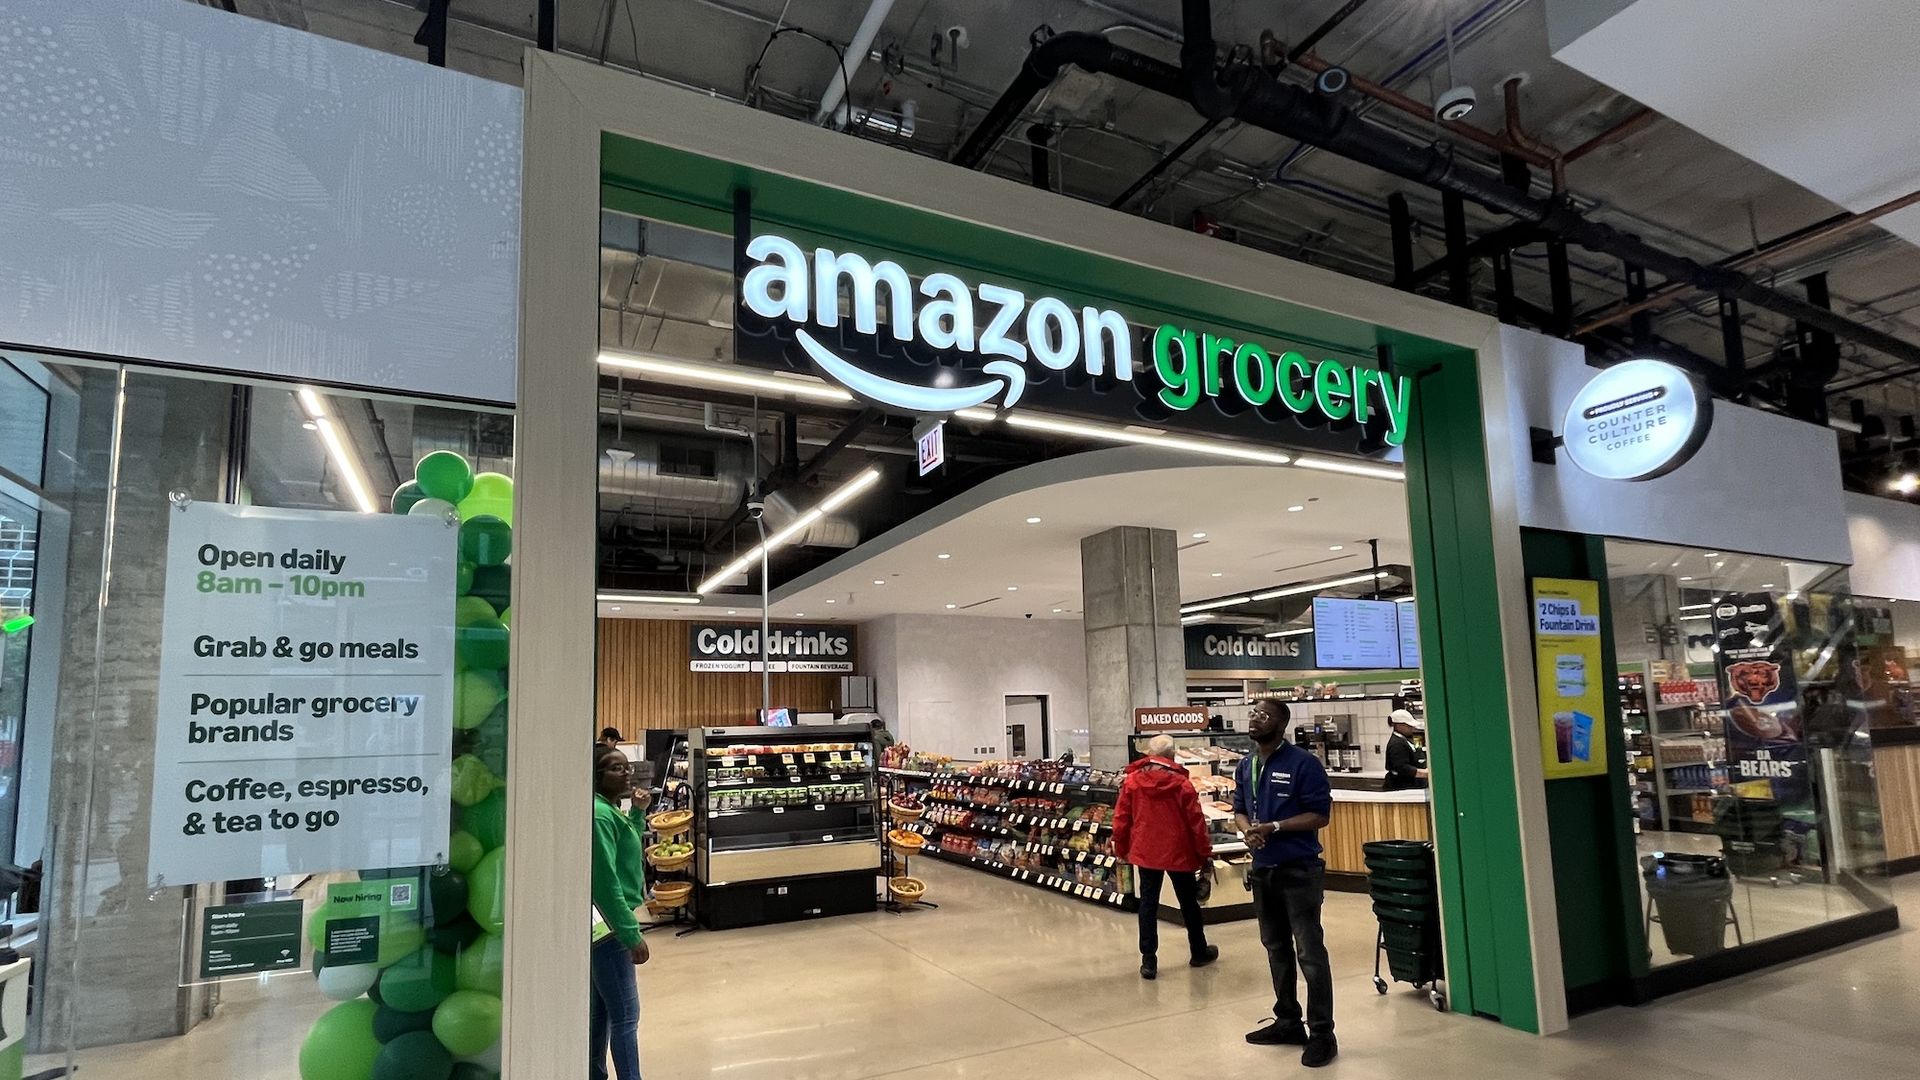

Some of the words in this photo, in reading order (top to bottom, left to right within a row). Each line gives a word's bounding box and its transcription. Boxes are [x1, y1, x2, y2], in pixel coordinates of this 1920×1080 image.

[743, 235, 1132, 381] amazon
[1153, 323, 1411, 446] grocery
[1587, 404, 1666, 433] COUNTER
[1588, 415, 1667, 444] CULTURE
[921, 429, 938, 464] EXIT
[1606, 433, 1651, 451] COFFEE
[197, 543, 275, 571] Open
[280, 548, 347, 575] daily
[196, 570, 262, 594] 8am
[290, 574, 365, 600] 10pm
[1547, 603, 1570, 618] Chips
[1570, 604, 1577, 616] &
[1539, 618, 1574, 631] Fountain
[1575, 619, 1596, 632] Drink
[193, 634, 267, 658] Grab
[272, 635, 294, 658] &
[299, 641, 334, 662] go
[339, 638, 419, 659] meals
[697, 627, 760, 655] Cold
[767, 629, 848, 656] drinks
[1203, 634, 1244, 656] Cold
[1247, 636, 1300, 657] drinks
[695, 662, 720, 670] FROZEN
[720, 662, 745, 670] YOGURT
[190, 693, 306, 719] Popular
[311, 696, 419, 718] grocery
[1140, 713, 1172, 725] BAKED
[1172, 712, 1204, 724] GOODS
[188, 720, 294, 744] brands
[1740, 760, 1792, 778] BEARS
[184, 777, 292, 803] Coffee,
[297, 776, 429, 801] espresso,
[182, 812, 206, 836] &
[211, 811, 262, 834] tea
[268, 808, 300, 830] to
[304, 809, 340, 833] go
[333, 895, 354, 904] Now
[355, 893, 382, 903] hiring
